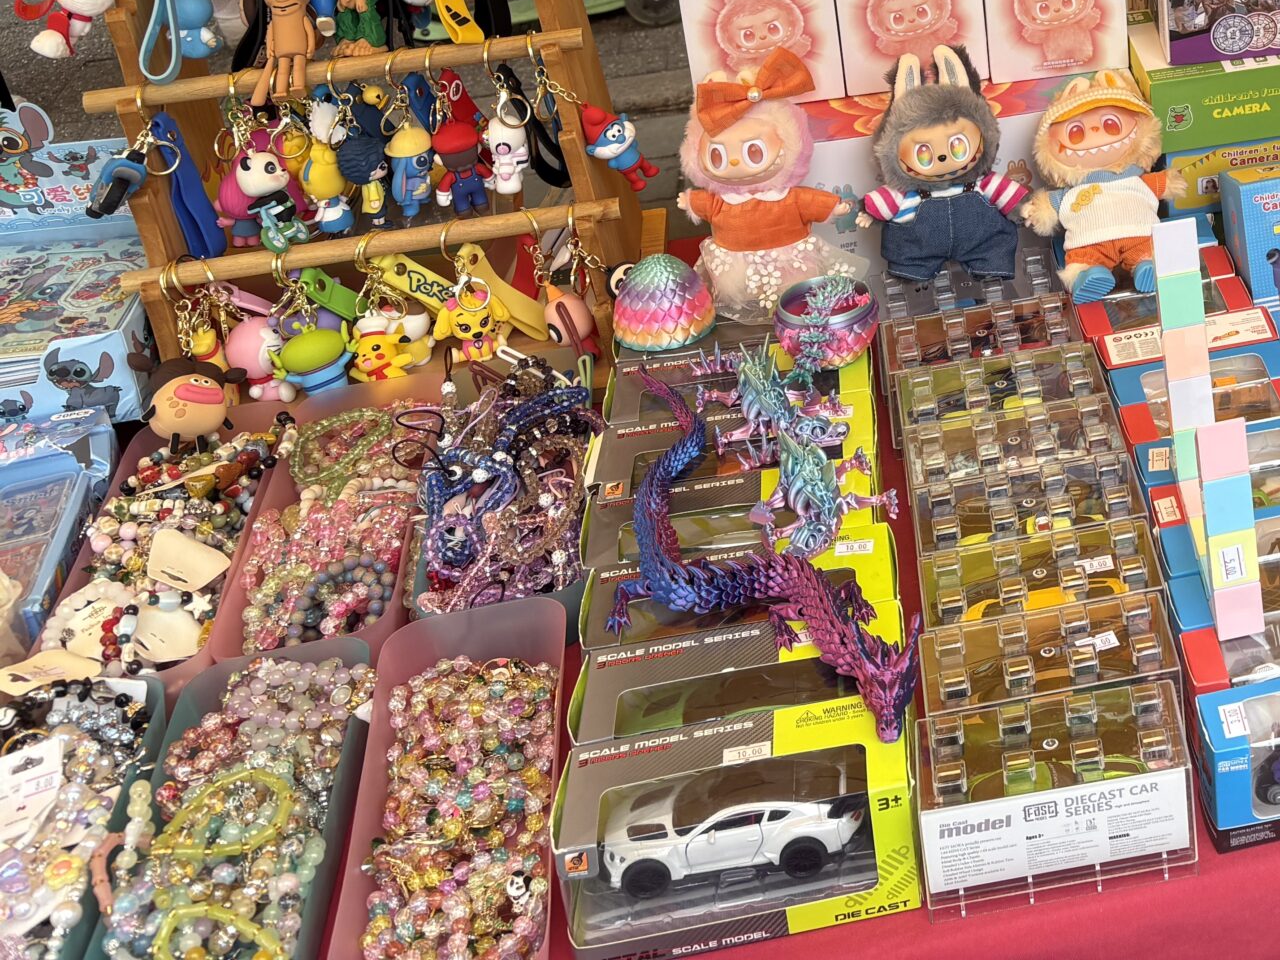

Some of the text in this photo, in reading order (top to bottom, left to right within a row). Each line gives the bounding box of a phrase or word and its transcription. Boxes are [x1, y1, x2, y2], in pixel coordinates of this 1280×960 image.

[1212, 102, 1271, 119] CAMERA
[1221, 145, 1268, 159] Children's
[1229, 152, 1279, 167] Camera
[617, 424, 658, 435] SCALE
[694, 478, 744, 491] SERIES
[600, 567, 641, 579] SCAL
[1224, 558, 1237, 576] 5.00
[596, 629, 760, 663] SCALE MODEL SERIES
[822, 701, 865, 715] WARNING:
[795, 713, 823, 725] CHOKING
[823, 710, 848, 720] HAZARD
[812, 718, 832, 726] children
[578, 721, 754, 761] SCALE MODEL SERIES
[736, 747, 763, 758] 10.00
[877, 795, 902, 811] 3+
[1064, 782, 1159, 808] DIECAST CAR
[1065, 800, 1113, 818] SERIES
[939, 815, 1012, 840] model
[834, 899, 912, 922] DIE CAST
[672, 930, 771, 955] SCALE MODEL
